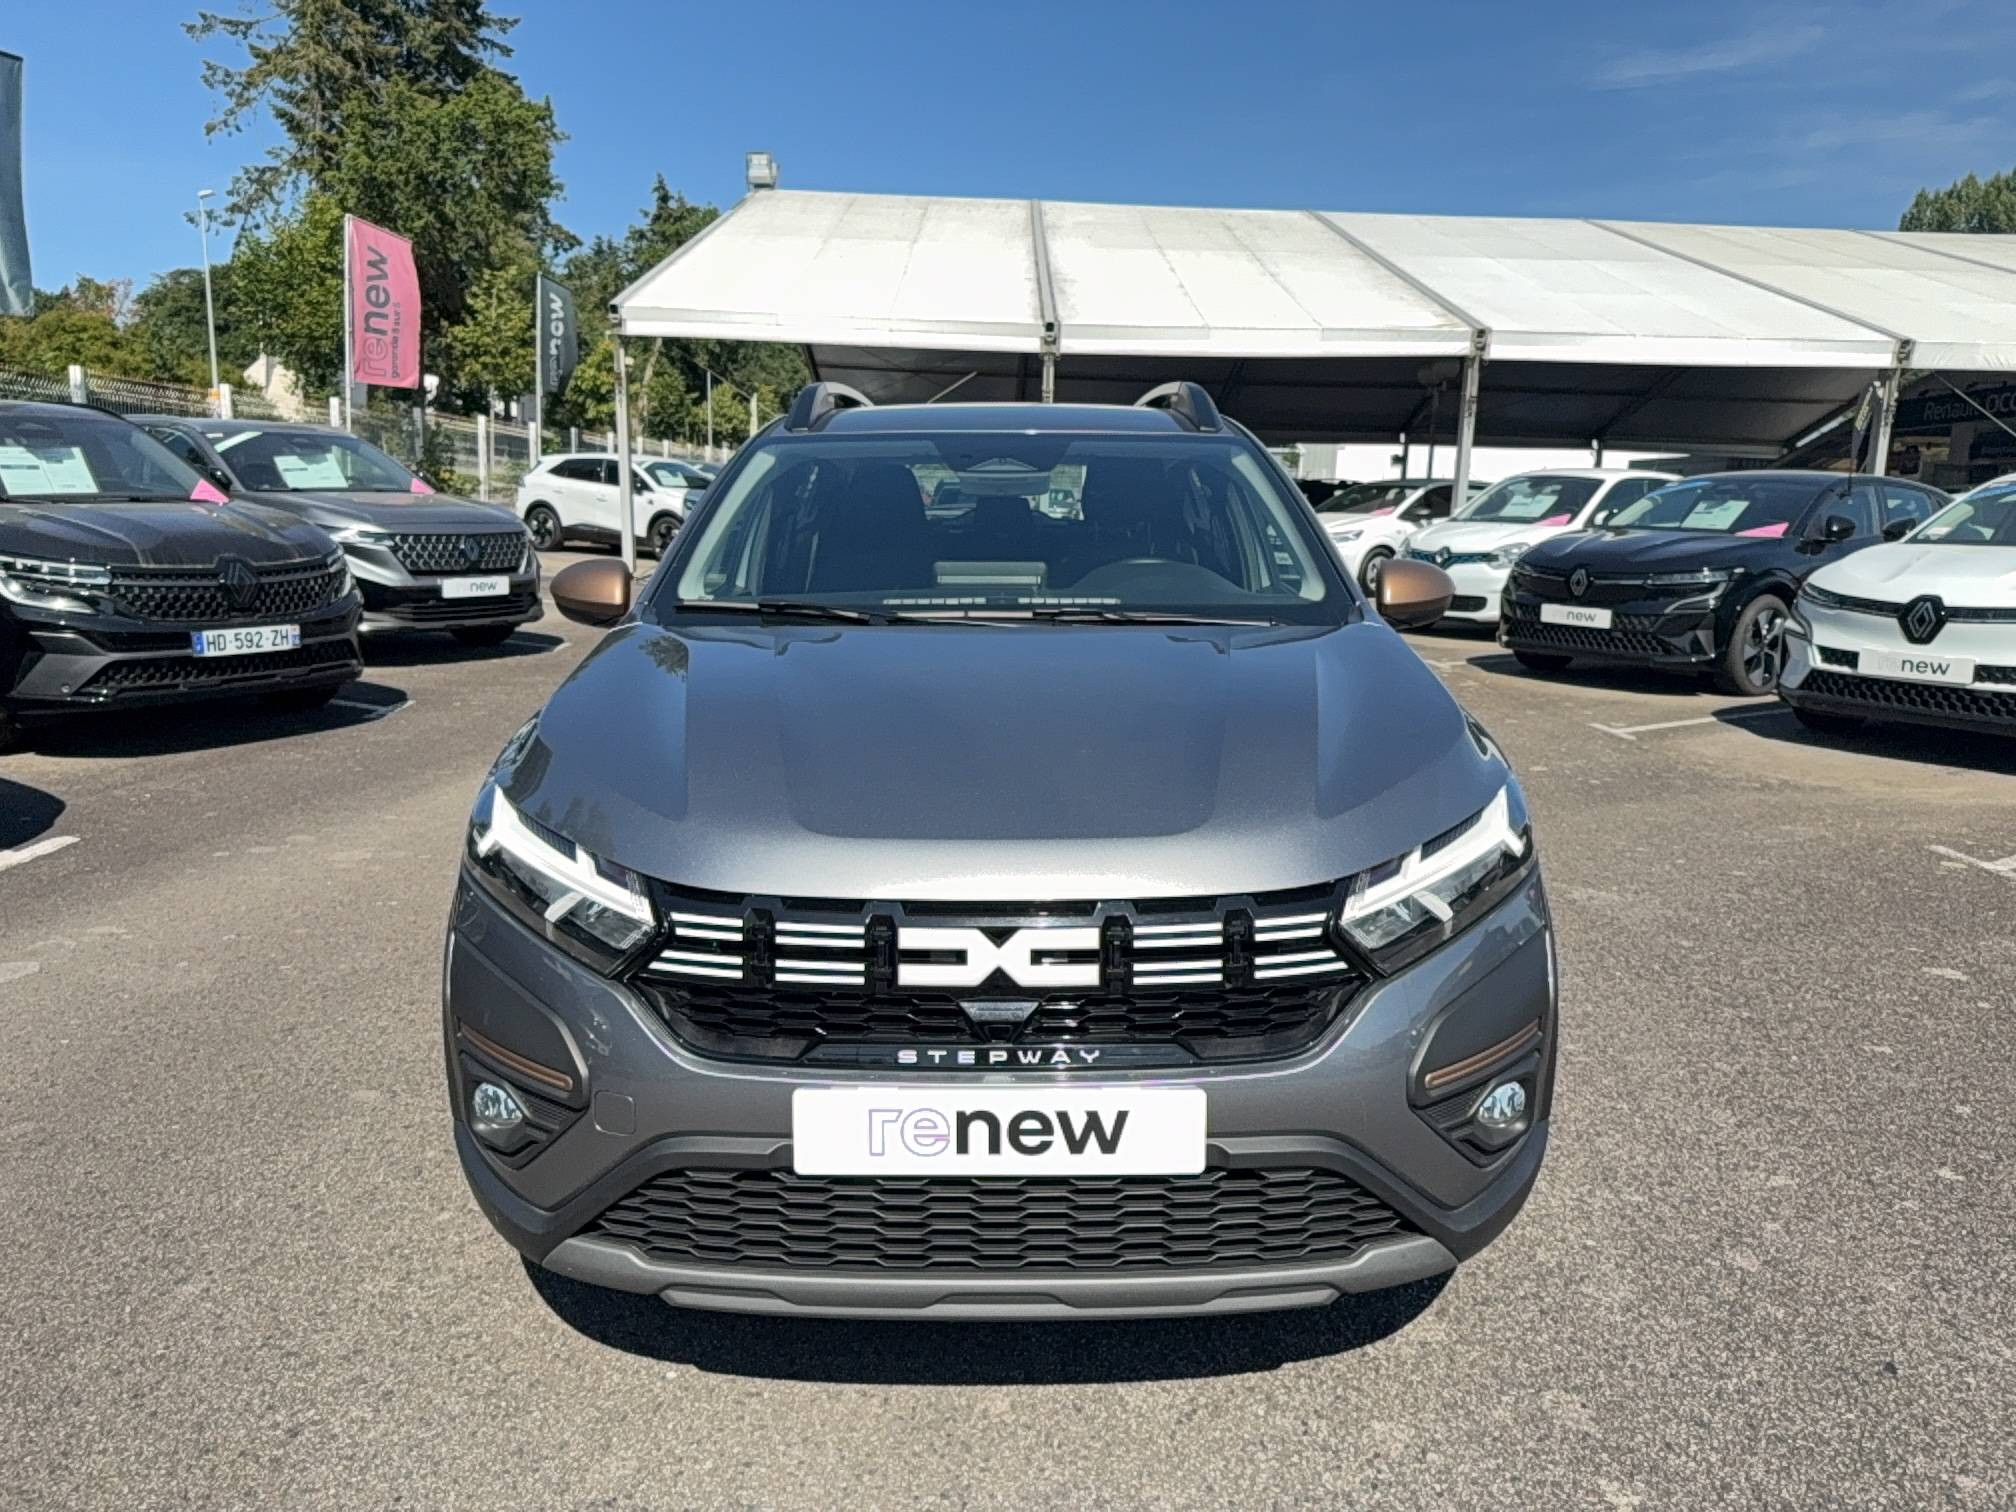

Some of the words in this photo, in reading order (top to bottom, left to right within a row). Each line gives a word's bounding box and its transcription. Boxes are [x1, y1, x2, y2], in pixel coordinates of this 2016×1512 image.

[363, 246, 390, 379] renew
[897, 1050, 1100, 1064] STEPWAY
[868, 1108, 1130, 1157] renew
